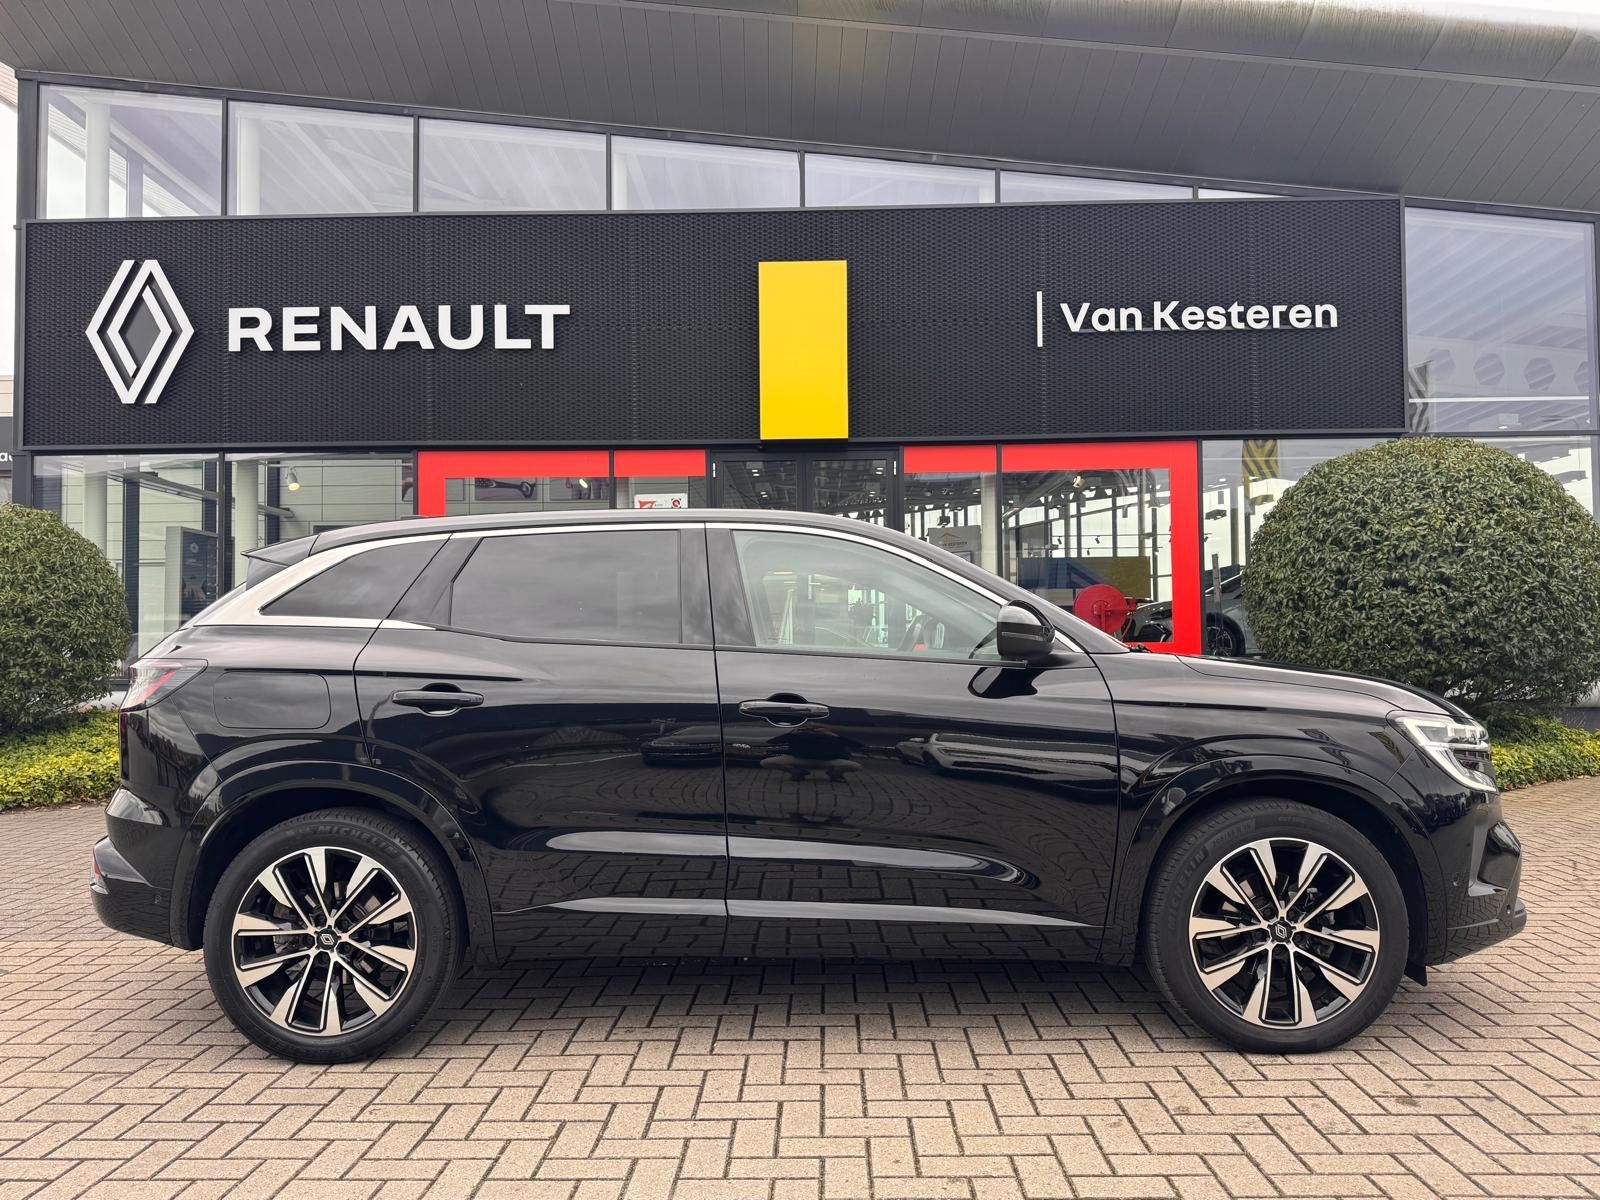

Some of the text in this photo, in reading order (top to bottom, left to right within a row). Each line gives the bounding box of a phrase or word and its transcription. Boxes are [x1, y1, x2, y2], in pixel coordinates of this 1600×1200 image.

[228, 305, 570, 351] RENAULT
[1060, 300, 1338, 333] Van Kesteren
[318, 825, 399, 855] MICHELIN
[1168, 848, 1208, 932] MICHELIN
